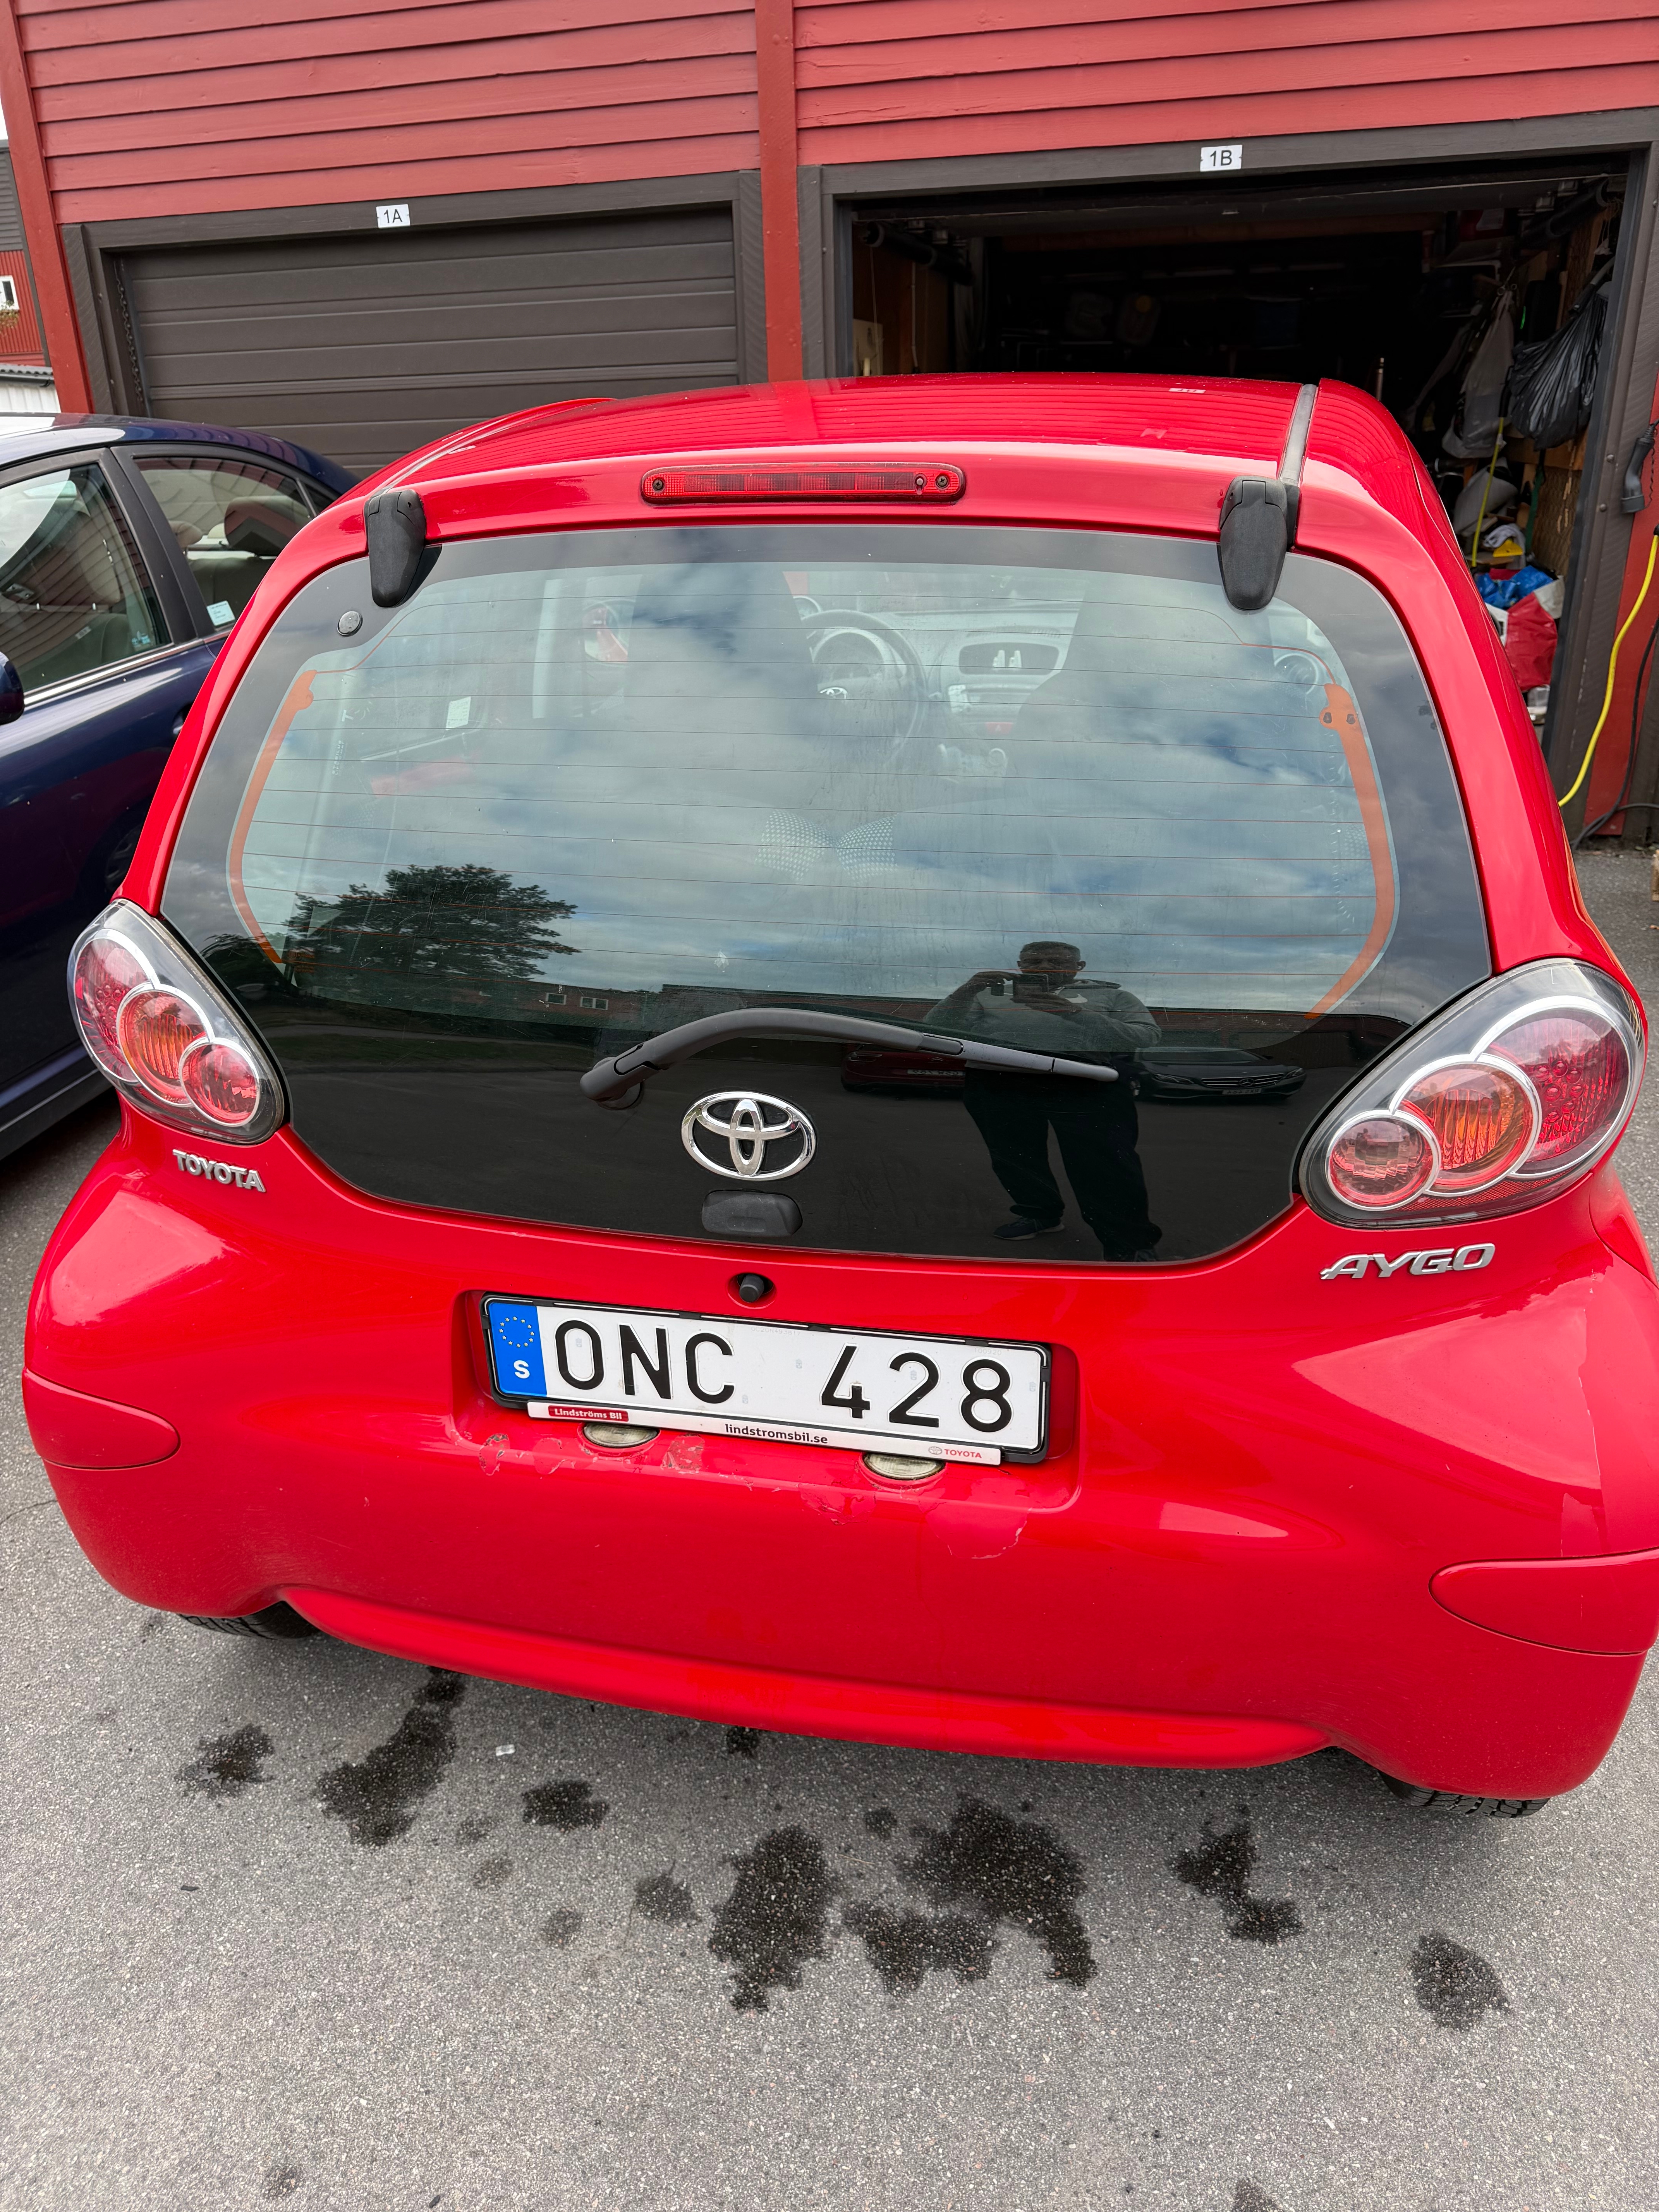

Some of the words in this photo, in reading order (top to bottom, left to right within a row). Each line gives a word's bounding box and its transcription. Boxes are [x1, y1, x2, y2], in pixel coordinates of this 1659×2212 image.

[1210, 150, 1232, 167] 1B
[383, 209, 403, 223] 1A
[172, 1149, 266, 1193] TOYOTA
[1319, 1243, 1496, 1279] AYGO
[514, 1360, 530, 1379] S
[555, 1320, 735, 1404] ONC
[821, 1345, 1012, 1433] 428
[554, 1408, 607, 1418] Lindströms
[725, 1424, 828, 1444] lindstromsbil.se
[944, 1449, 982, 1458] TOYOTA
